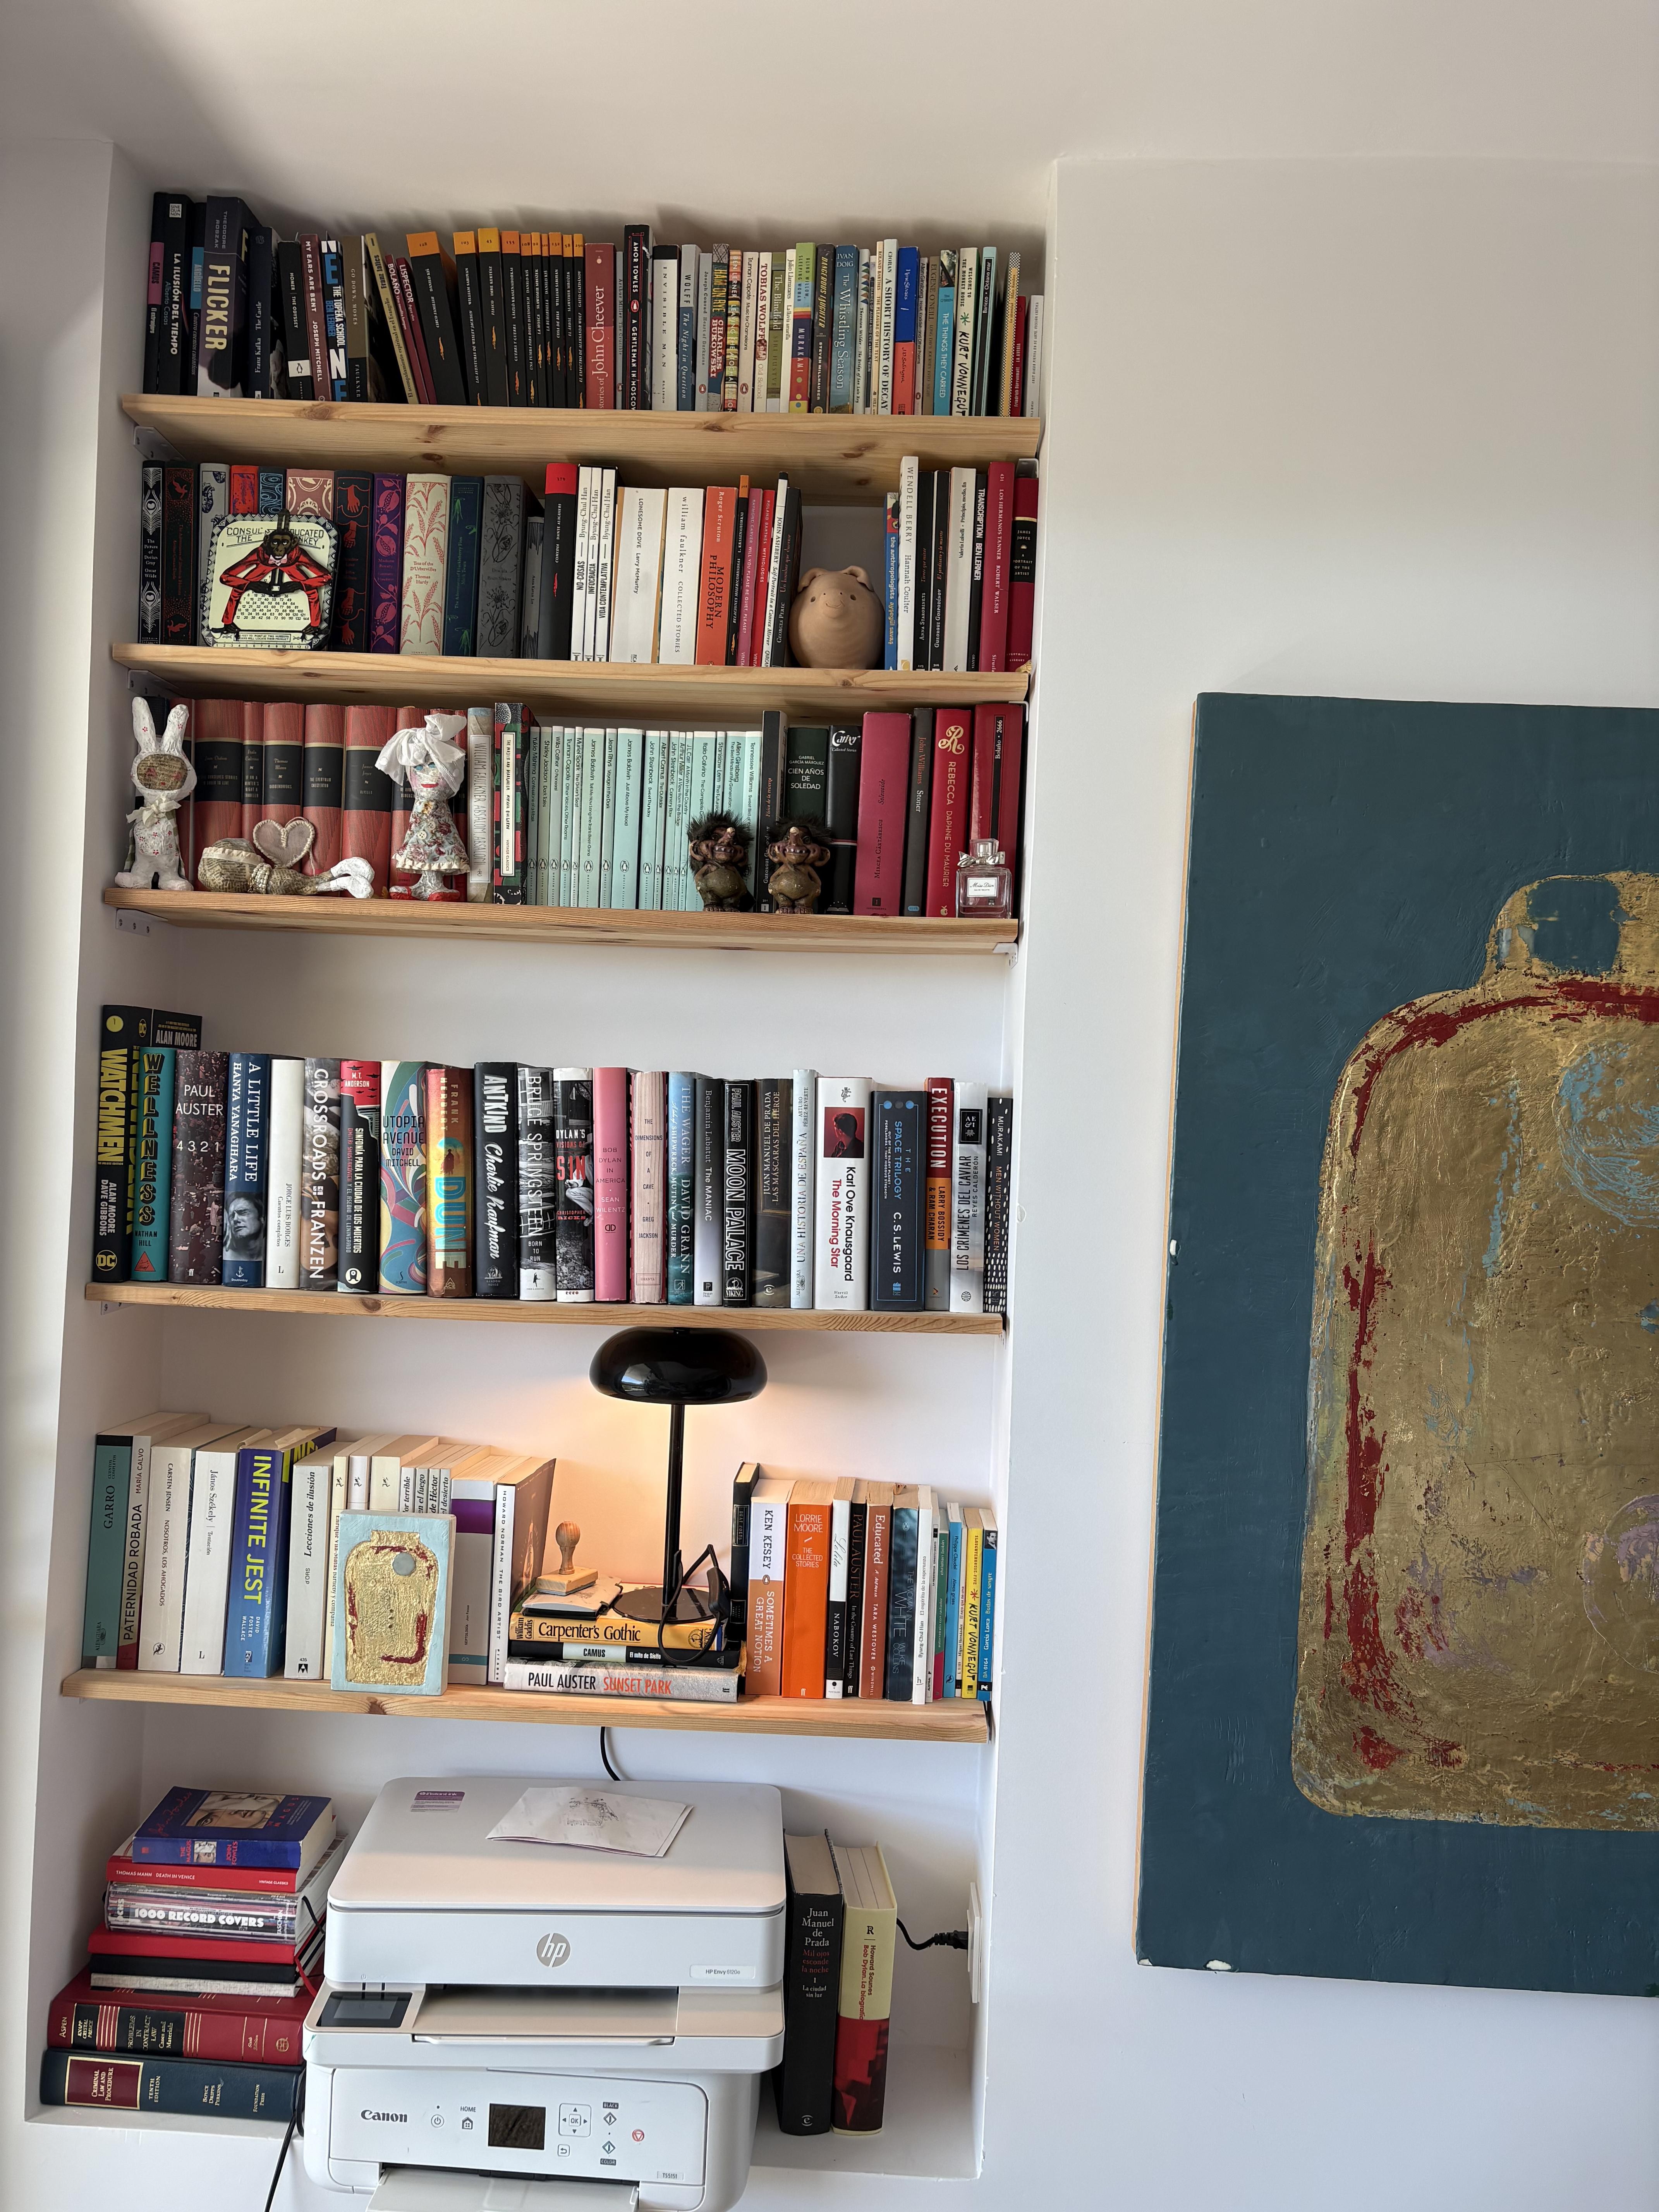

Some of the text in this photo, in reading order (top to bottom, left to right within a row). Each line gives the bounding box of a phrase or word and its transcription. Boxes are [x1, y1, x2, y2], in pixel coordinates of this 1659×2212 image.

[173, 254, 181, 264] LA
[306, 241, 311, 250] MY
[173, 266, 182, 302] ILUSIÓN
[205, 264, 230, 350] FLICKER
[333, 285, 345, 347] THE TOPEKA SCHOOL
[834, 289, 851, 347] Whistling
[592, 286, 608, 377] John Cheever
[836, 350, 848, 388] Season
[883, 365, 889, 377] OF
[954, 331, 969, 416] KURT VONNEGUT
[881, 380, 889, 410] DECAY
[579, 502, 587, 538] Byung-Chul
[603, 503, 611, 540] Byung-Chul
[976, 488, 985, 538] TRANSCRIPTION
[599, 563, 608, 605] CONTEMPLATIVA
[634, 568, 642, 594] McMurtry
[974, 557, 982, 581] LERNER
[706, 555, 717, 629] PHILOSOPHY
[714, 566, 724, 618] MODERN
[474, 743, 486, 771] WILLIAM
[474, 774, 486, 803] FAULKNER
[946, 762, 956, 805] REBECCA
[945, 811, 953, 840] DAPHNE
[945, 843, 951, 853] DU
[156, 1030, 197, 1047] ALAN MOORE
[98, 1048, 128, 1161] WATCHMEN
[176, 1103, 223, 1115] AUSTER
[184, 1085, 215, 1097] PAUL
[140, 1053, 165, 1226] WELLNESS
[229, 1062, 242, 1181] HANYA YANAGIHARA
[245, 1062, 261, 1182] A LITTLE LIFE
[383, 1115, 424, 1128] UTOPIA
[383, 1132, 424, 1144] AVENUE
[930, 1088, 947, 1168] EXECUTION
[310, 1068, 328, 1279] CROSSROADS FRANZEN
[386, 1159, 420, 1167] MITCHELL
[483, 1075, 509, 1259] ANTKIND Charlie Kaufman
[527, 1076, 543, 1236] BRUCE SPRINGSTEEN
[557, 1156, 586, 1180] SIN
[435, 1176, 467, 1269] DUNE
[726, 1149, 746, 1271] MOON PALACE
[829, 1179, 842, 1268] The Morning Star
[845, 1167, 855, 1281] Karl Ove Knausgaard
[103, 1485, 115, 1529] GARRO
[304, 1472, 315, 1557] Lecciones de ilusión
[795, 1513, 823, 1523] LORRIE
[244, 1456, 271, 1604] INFINITE JEST
[763, 1510, 773, 1569] KEN KESEY
[793, 1523, 823, 1532] MOORE
[873, 1514, 885, 1564] Educated
[124, 1504, 142, 1640] PATERNIDAD ROBADA
[604, 1623, 641, 1642] Gothic
[967, 1603, 978, 1681] KURT VONNEGUT
[583, 1649, 606, 1657] CAMUS
[528, 1672, 672, 1694] PAUL AUSTER SUNSET PARK
[135, 1908, 264, 1928] 1000 RECORD COVERS
[802, 1918, 834, 1928] Manuel
[807, 1908, 828, 1918] Juan
[804, 1938, 829, 1946] Prada
[812, 1929, 823, 1937] de
[361, 2109, 407, 2123] Canon
